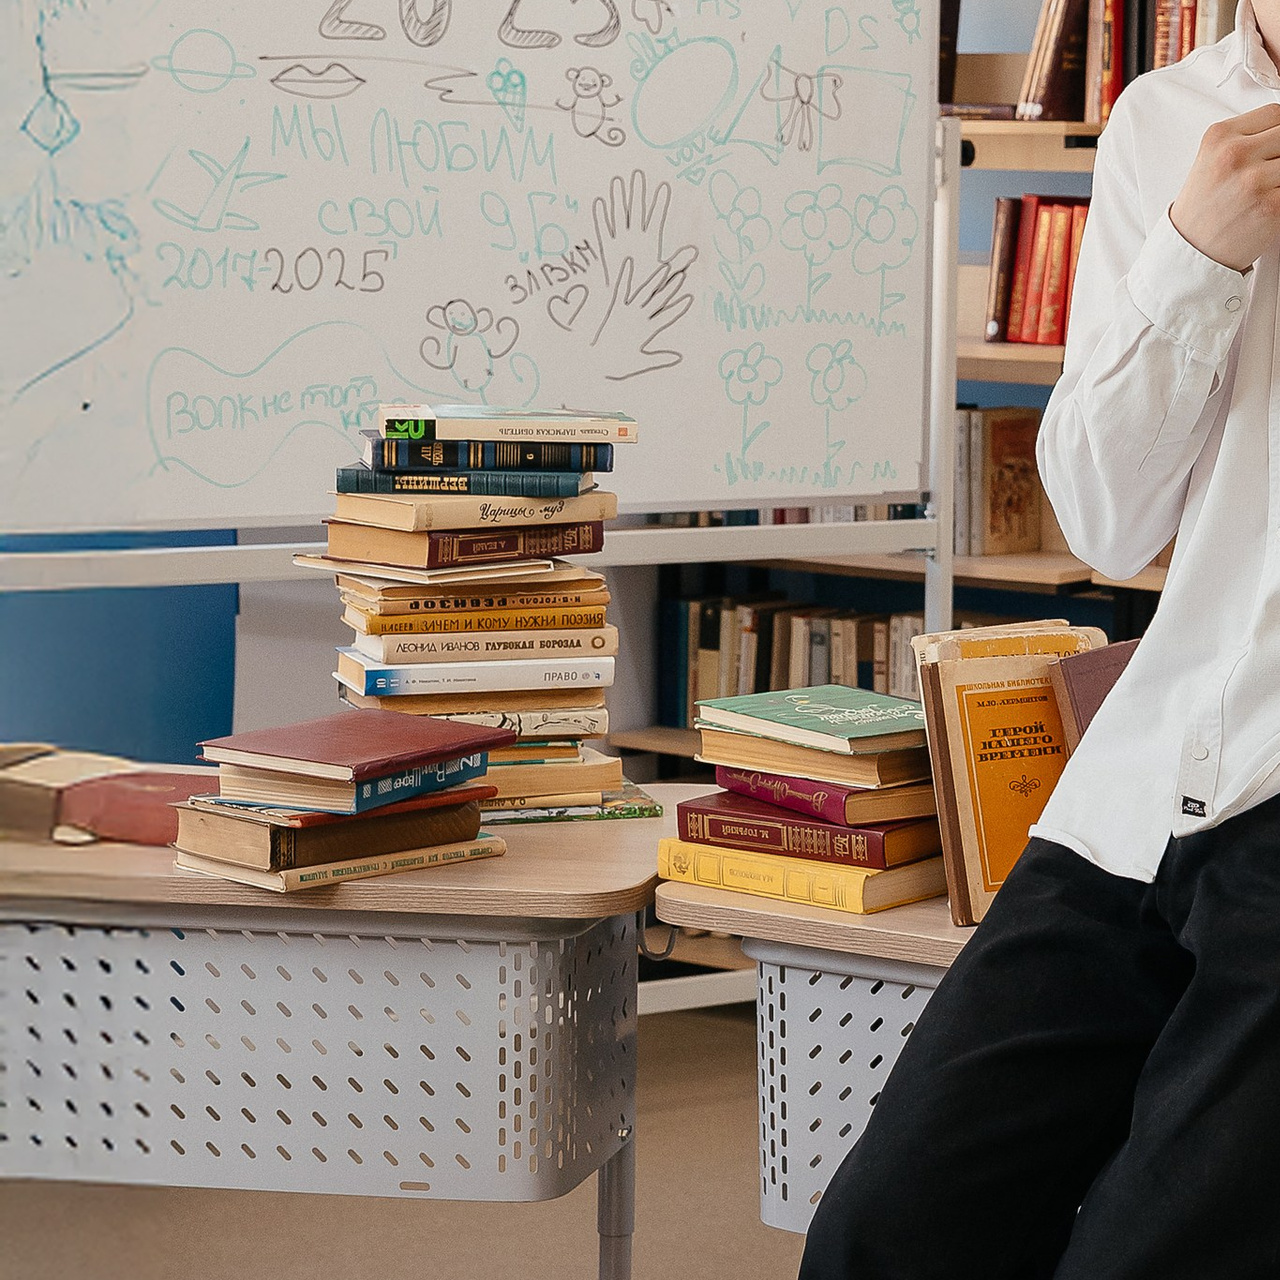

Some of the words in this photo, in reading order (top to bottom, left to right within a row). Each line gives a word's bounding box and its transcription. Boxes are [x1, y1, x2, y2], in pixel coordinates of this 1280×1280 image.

[271, 104, 349, 166] МЫ
[370, 107, 557, 187] ЛЮБИМ
[317, 185, 443, 238] СВОЙ
[498, 428, 534, 436] ОБИТЕЛЬ
[536, 427, 577, 436] ПАРМСКАЯ
[395, 476, 468, 492] ВЕРШИНЫ
[479, 502, 535, 522] Царицы
[409, 597, 508, 610] РЕВИЗОР
[420, 618, 460, 632] ЗАЧЕМ
[464, 619, 473, 630] И
[477, 616, 509, 630] КОМУ
[514, 614, 556, 629] НУЖНА
[561, 612, 603, 627] ПОЭЗИЯ
[396, 641, 438, 654] ЛЕОНИД
[441, 640, 480, 652] ИВАНОВ
[485, 639, 535, 651] ГЛУБОКАЯ
[539, 637, 583, 649] БОРОЗДА
[543, 671, 578, 682] ПРАВО
[966, 681, 1005, 691] ШКОЛЬНАЯ
[1007, 677, 1052, 688] БИБЛИОТЕК
[989, 720, 1046, 739] ГЕРОЙ
[981, 734, 1053, 751] НАШЕГО
[977, 746, 1063, 764] ВРЕМЕНИ
[721, 824, 758, 838] ГОРЬКИЙ
